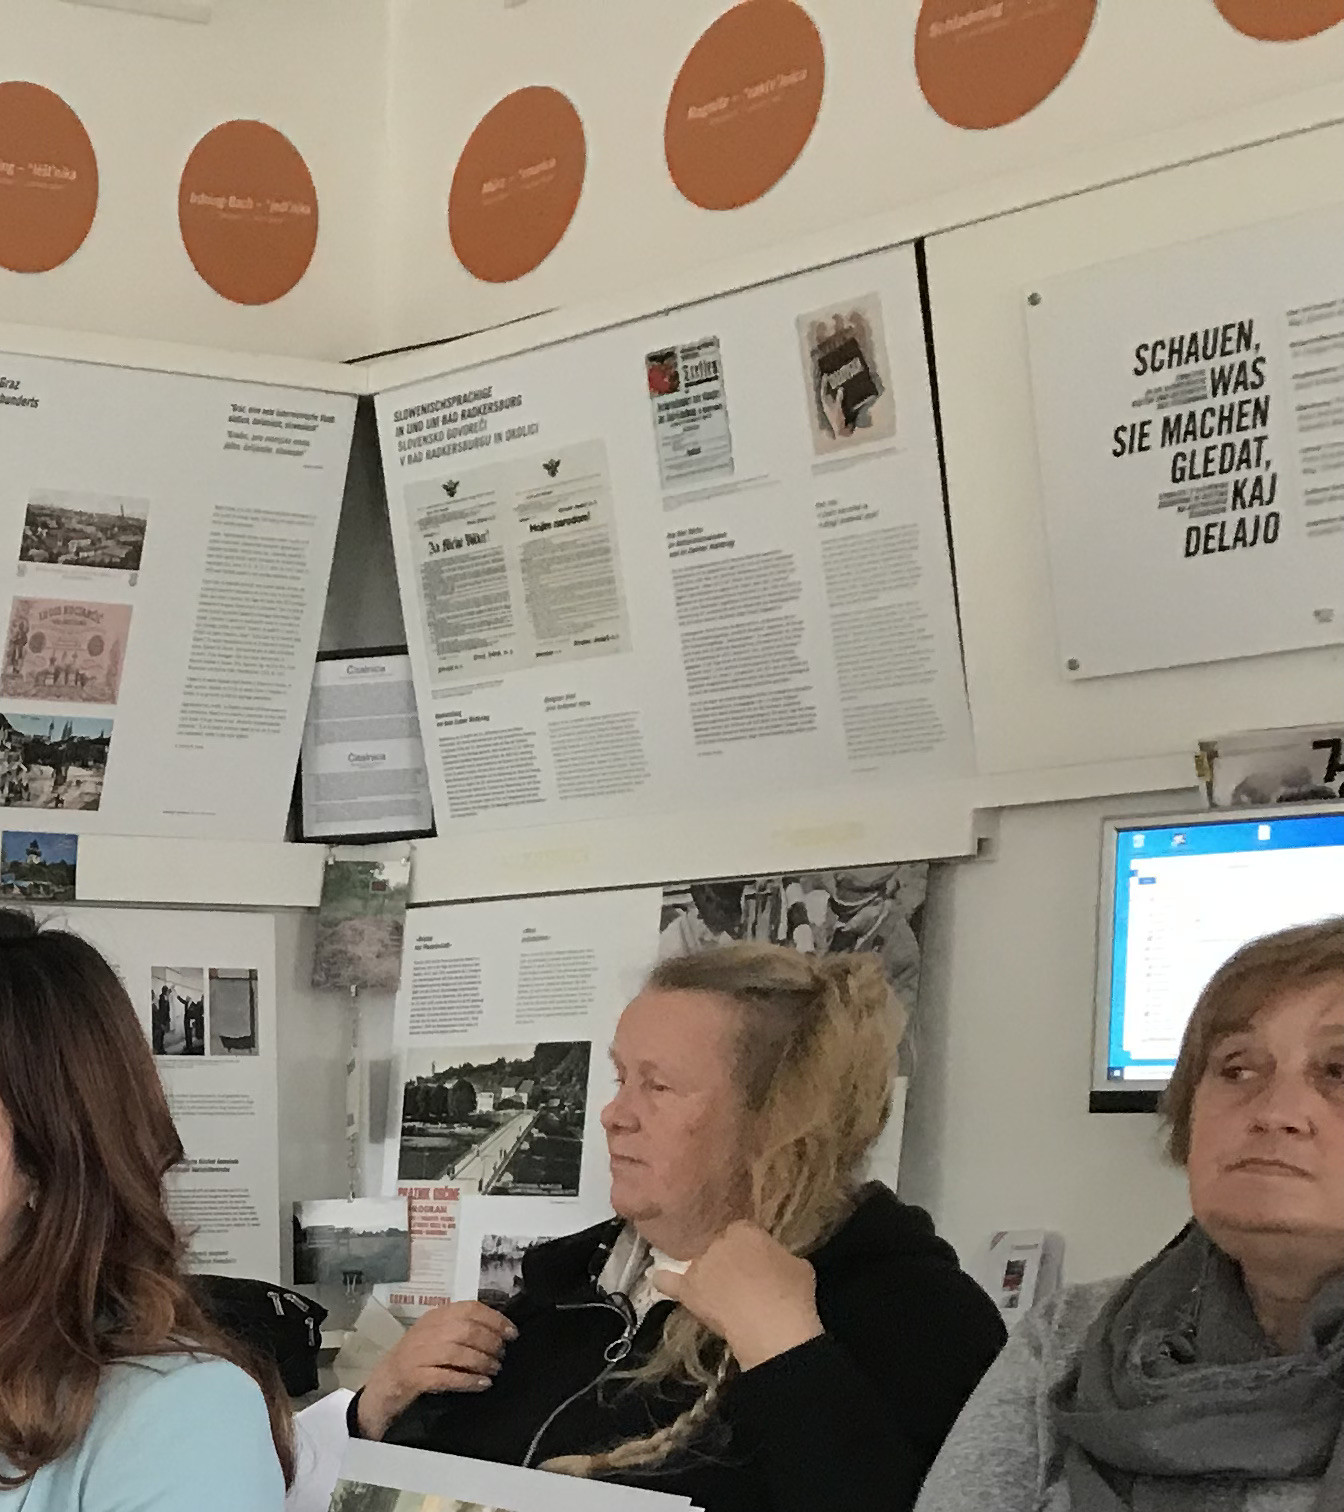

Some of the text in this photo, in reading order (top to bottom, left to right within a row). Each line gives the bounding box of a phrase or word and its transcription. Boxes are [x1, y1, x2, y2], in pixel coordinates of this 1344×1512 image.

[1133, 318, 1261, 377] SCHAUEN,
[1210, 356, 1267, 399] WAS
[406, 420, 424, 435] UND
[441, 411, 459, 426] BAD
[460, 394, 523, 421] RADKERSBURG
[1112, 394, 1271, 458] SIE MACHEN
[1171, 435, 1272, 484] GLEDAT,
[1231, 472, 1278, 511] KAJ
[1184, 511, 1281, 558] DELAJO
